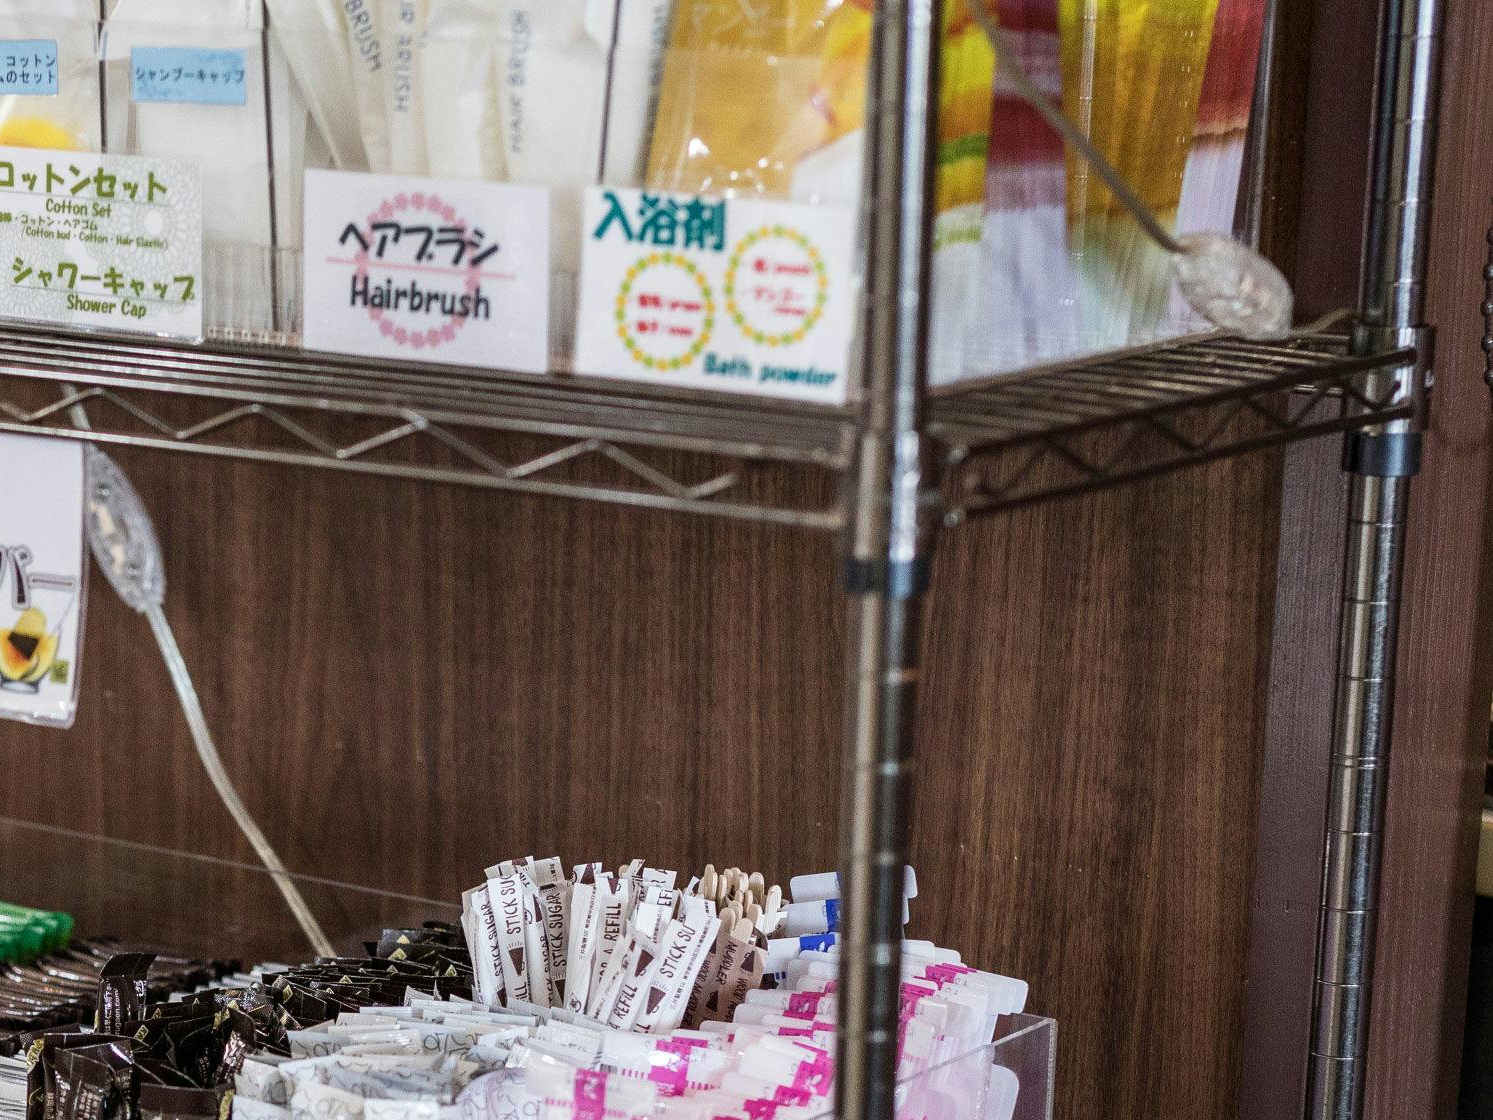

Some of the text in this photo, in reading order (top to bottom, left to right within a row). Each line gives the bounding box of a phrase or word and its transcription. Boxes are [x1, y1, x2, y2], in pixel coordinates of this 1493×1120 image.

[45, 198, 112, 218] Cotton Set
[593, 191, 728, 252] 入浴剤
[12, 256, 195, 301] シャワーキャップ
[66, 294, 147, 319] Shower Cap
[349, 275, 491, 321] Hairbrush
[504, 898, 522, 935] STICK
[545, 892, 563, 929] SUGAR
[548, 929, 568, 968] STICK
[659, 942, 687, 979] STICK
[715, 940, 739, 986] MUDDLER
